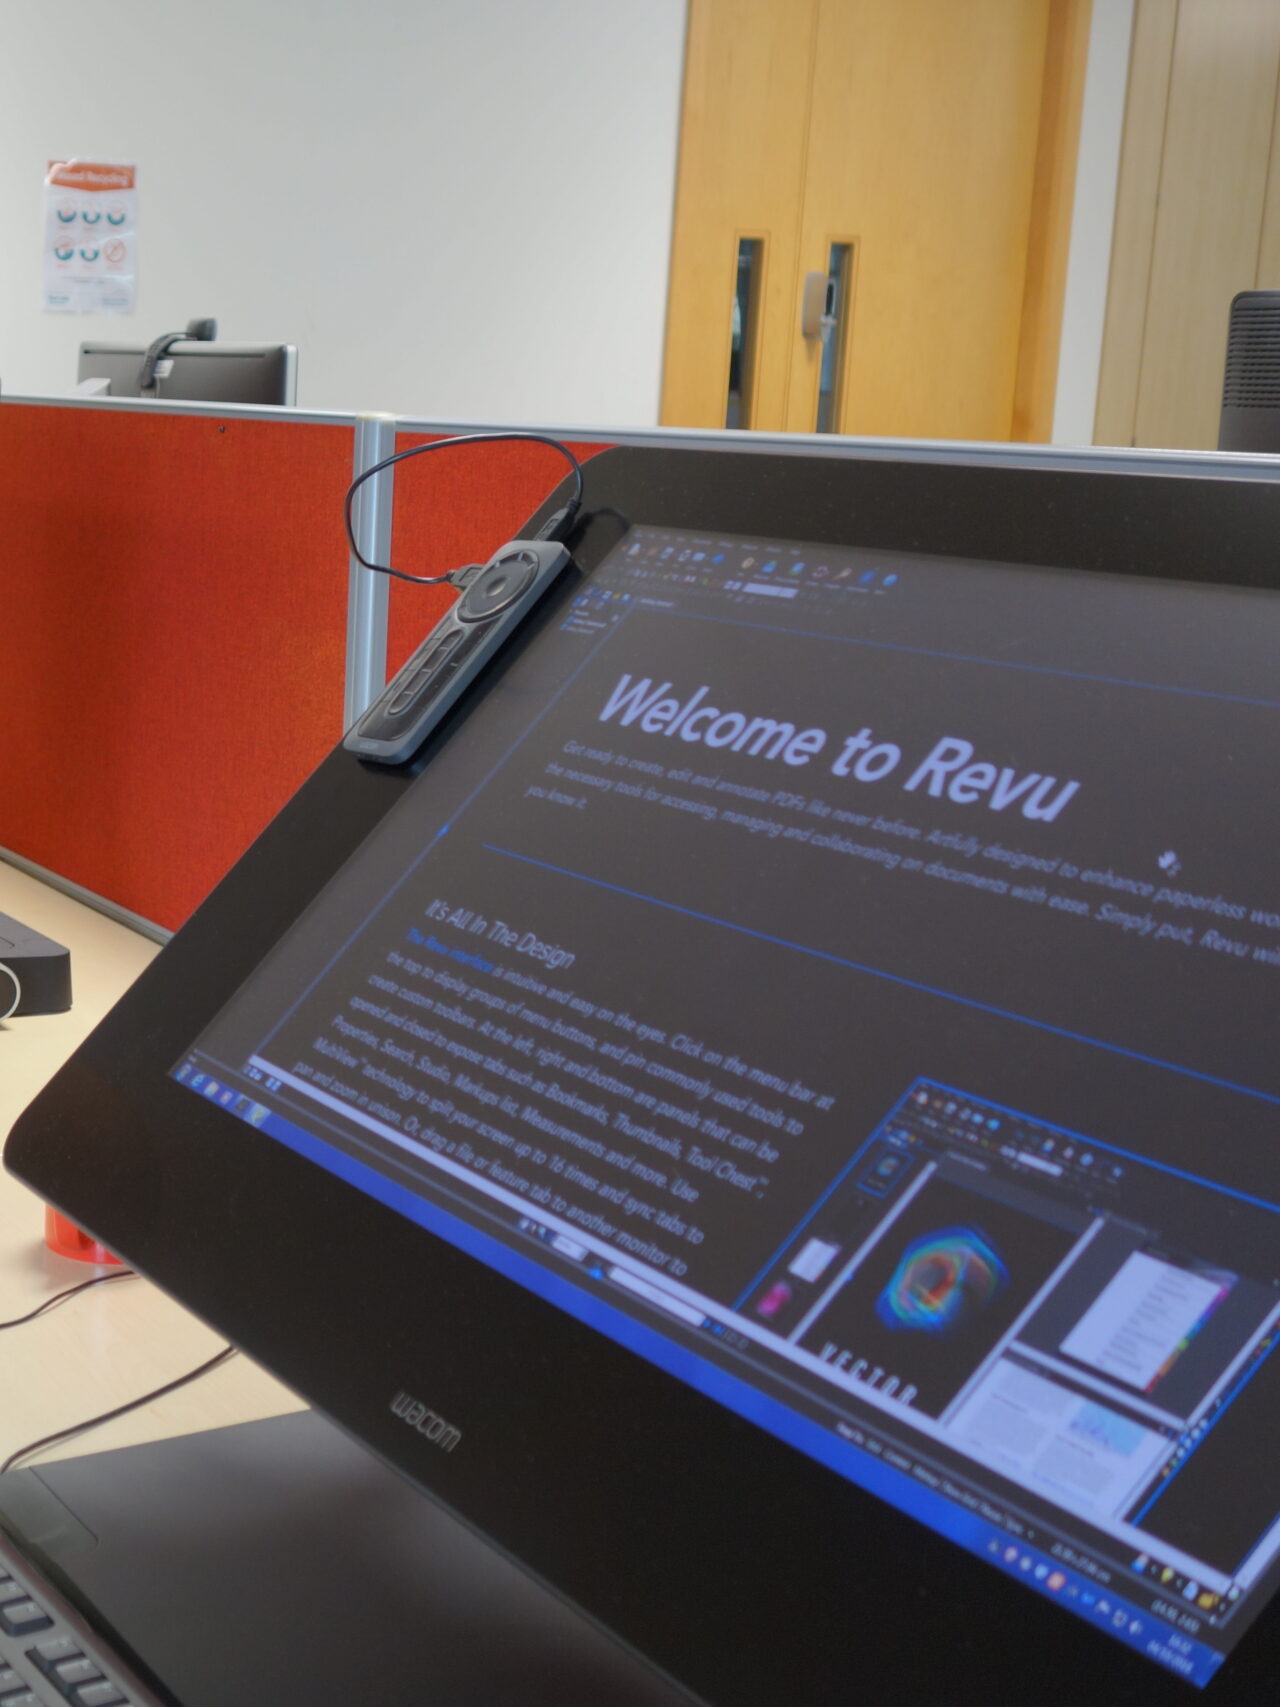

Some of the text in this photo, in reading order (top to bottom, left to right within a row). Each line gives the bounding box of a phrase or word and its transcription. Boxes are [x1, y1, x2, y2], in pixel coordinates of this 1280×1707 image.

[598, 673, 1080, 822] Welcome to Revu
[424, 898, 576, 970] It's All In The Design
[349, 996, 389, 1019] opened
[382, 1011, 408, 1028] and
[401, 1019, 439, 1042] closed
[432, 1032, 449, 1048] to
[445, 1040, 485, 1065] expose
[482, 1056, 508, 1076] tabs
[504, 1067, 533, 1087] such
[530, 1079, 548, 1094] as
[543, 1082, 609, 1125] Bookmarks,
[613, 1111, 682, 1160] Thumbnails,
[686, 1145, 720, 1171] Tool
[367, 974, 400, 994] create
[396, 987, 435, 1009] custom
[477, 1020, 495, 1037] At
[491, 1027, 514, 1045] the
[535, 1047, 566, 1068] right
[562, 1060, 593, 1079] and
[585, 1067, 635, 1098] bottom
[632, 1091, 657, 1109] are
[653, 1100, 702, 1129] panels
[699, 1118, 732, 1142] that
[728, 1133, 758, 1152] can
[755, 1141, 779, 1163] be
[386, 951, 804, 1136] the top to display groups of menu buttons, and pin commonly used tools to
[491, 966, 505, 978] is
[502, 970, 548, 995] intuitive
[545, 987, 574, 1005] and
[568, 997, 598, 1017] easy
[595, 1007, 615, 1022] on
[613, 1013, 637, 1031] the
[669, 1033, 704, 1058] Click
[701, 1050, 724, 1066] on
[722, 1056, 748, 1076] the
[747, 1067, 789, 1093] menu
[787, 1081, 817, 1102] bar
[814, 1095, 836, 1111] at
